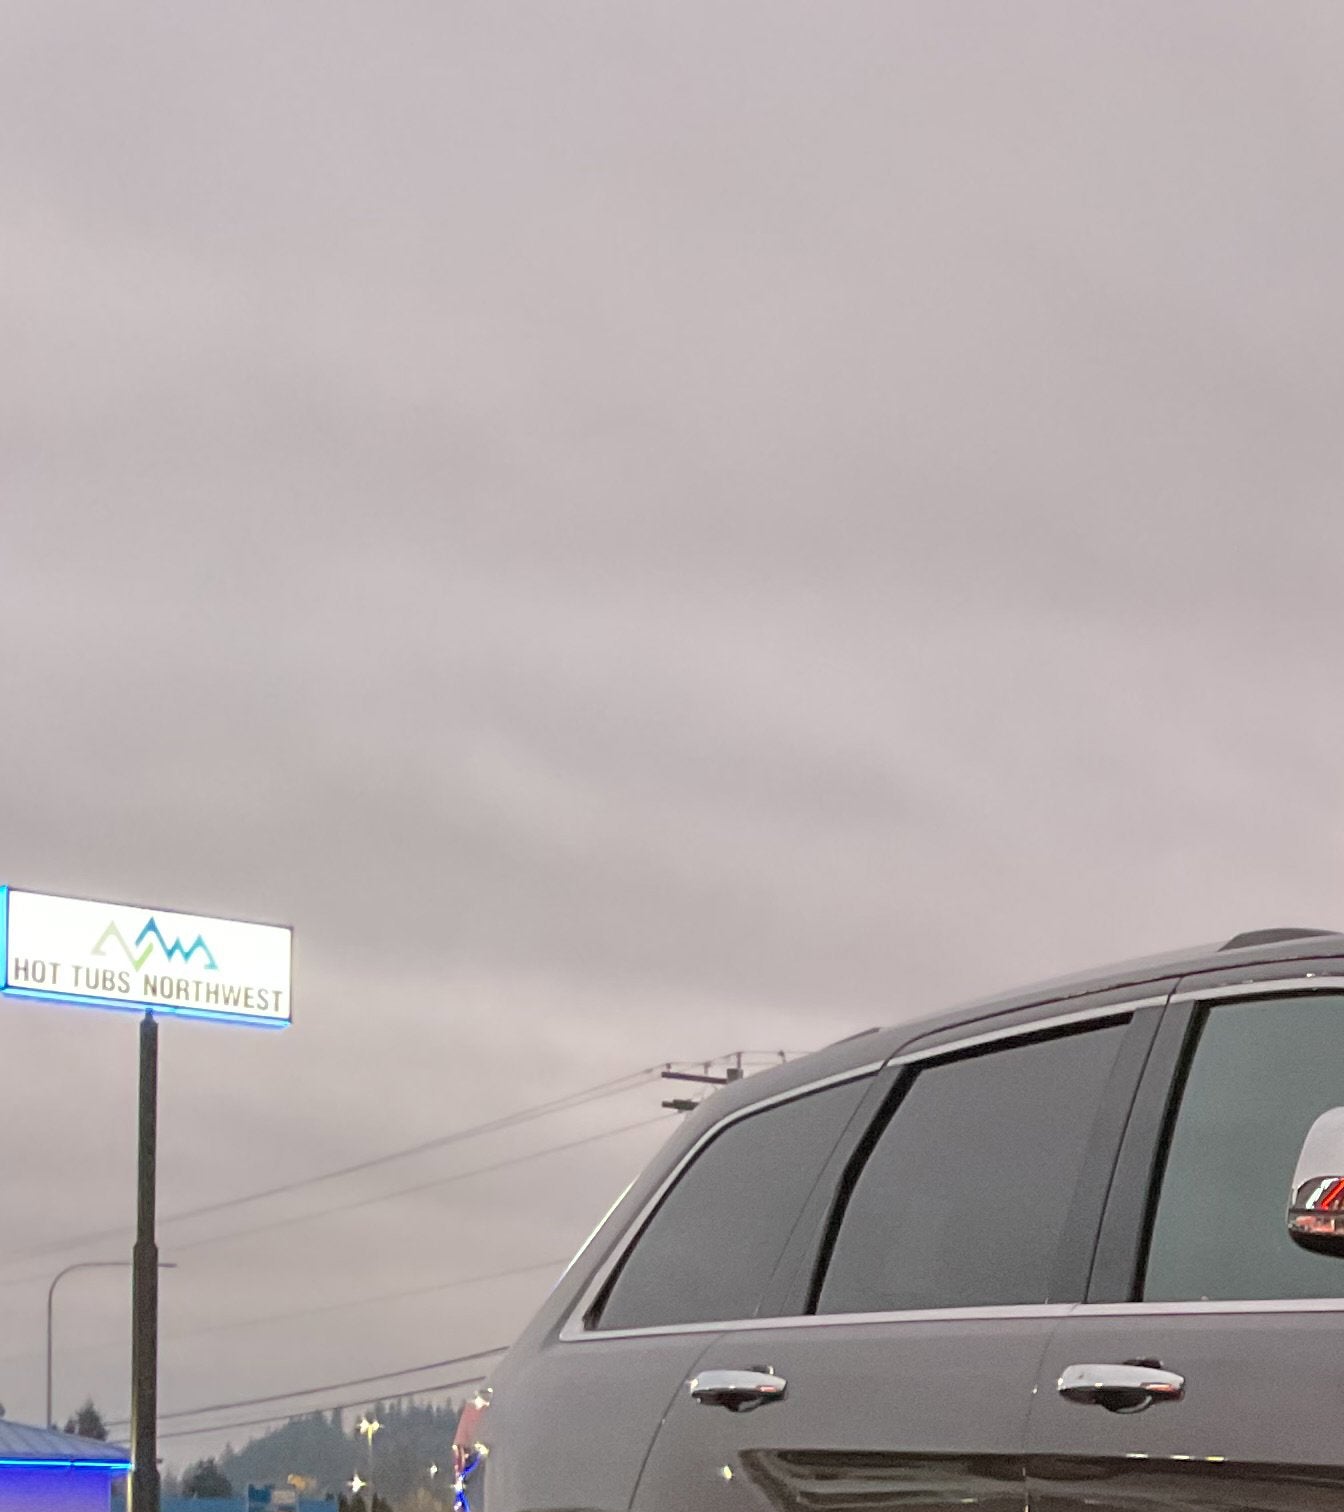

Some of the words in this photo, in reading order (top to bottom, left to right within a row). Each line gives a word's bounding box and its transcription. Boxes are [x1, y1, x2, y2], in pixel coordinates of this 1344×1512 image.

[14, 957, 61, 985] HOT
[72, 964, 131, 994] TUBS
[143, 973, 284, 1013] NORTHWEST
